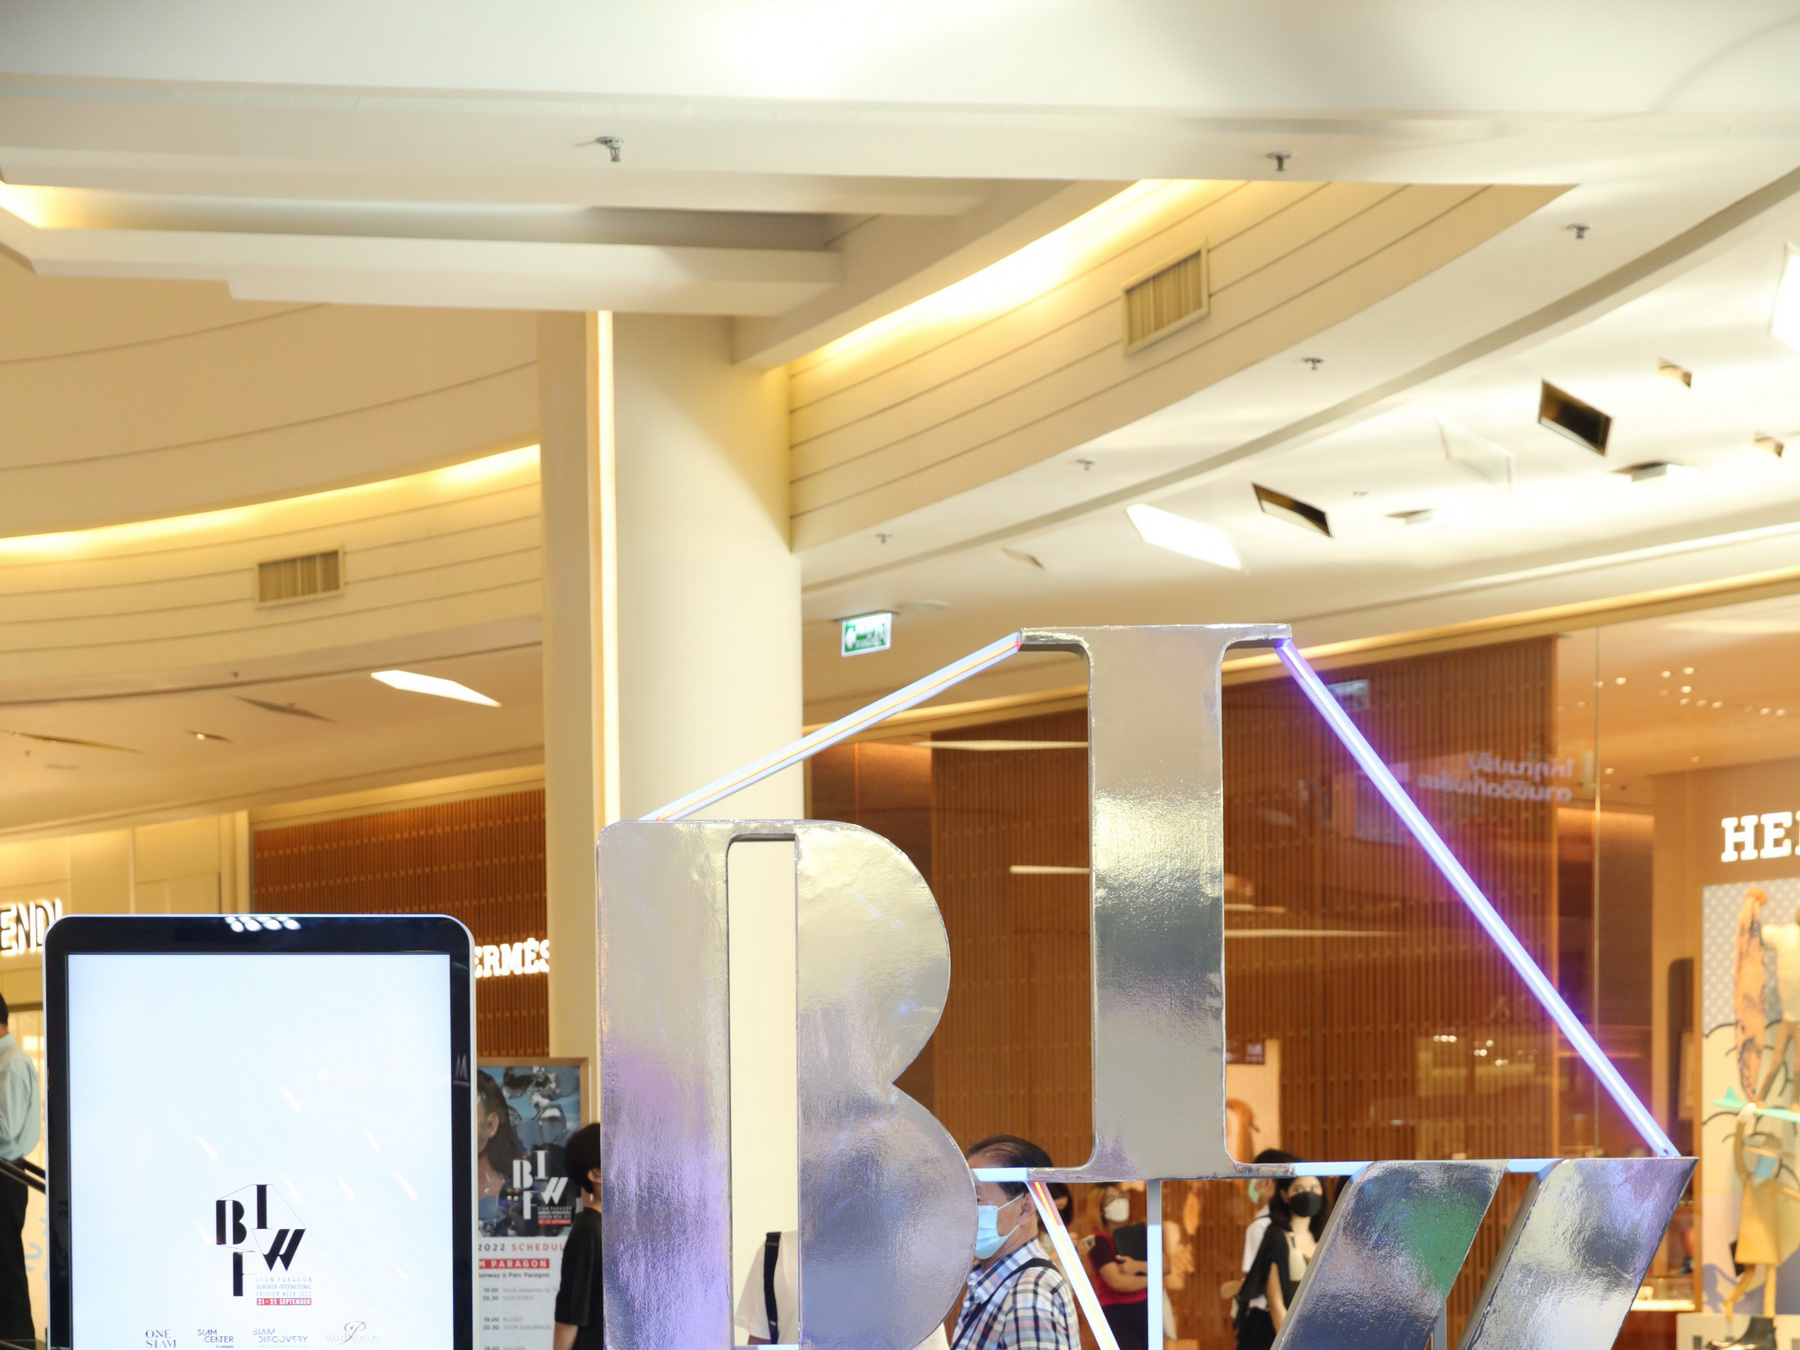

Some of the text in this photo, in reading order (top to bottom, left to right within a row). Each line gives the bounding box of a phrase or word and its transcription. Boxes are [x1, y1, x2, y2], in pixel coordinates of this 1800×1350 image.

[1721, 811, 1800, 862] HE
[479, 1243, 506, 1251] 2022
[491, 1259, 547, 1268] PARAGON
[145, 1329, 171, 1339] ONE
[145, 1339, 177, 1349] SIAM
